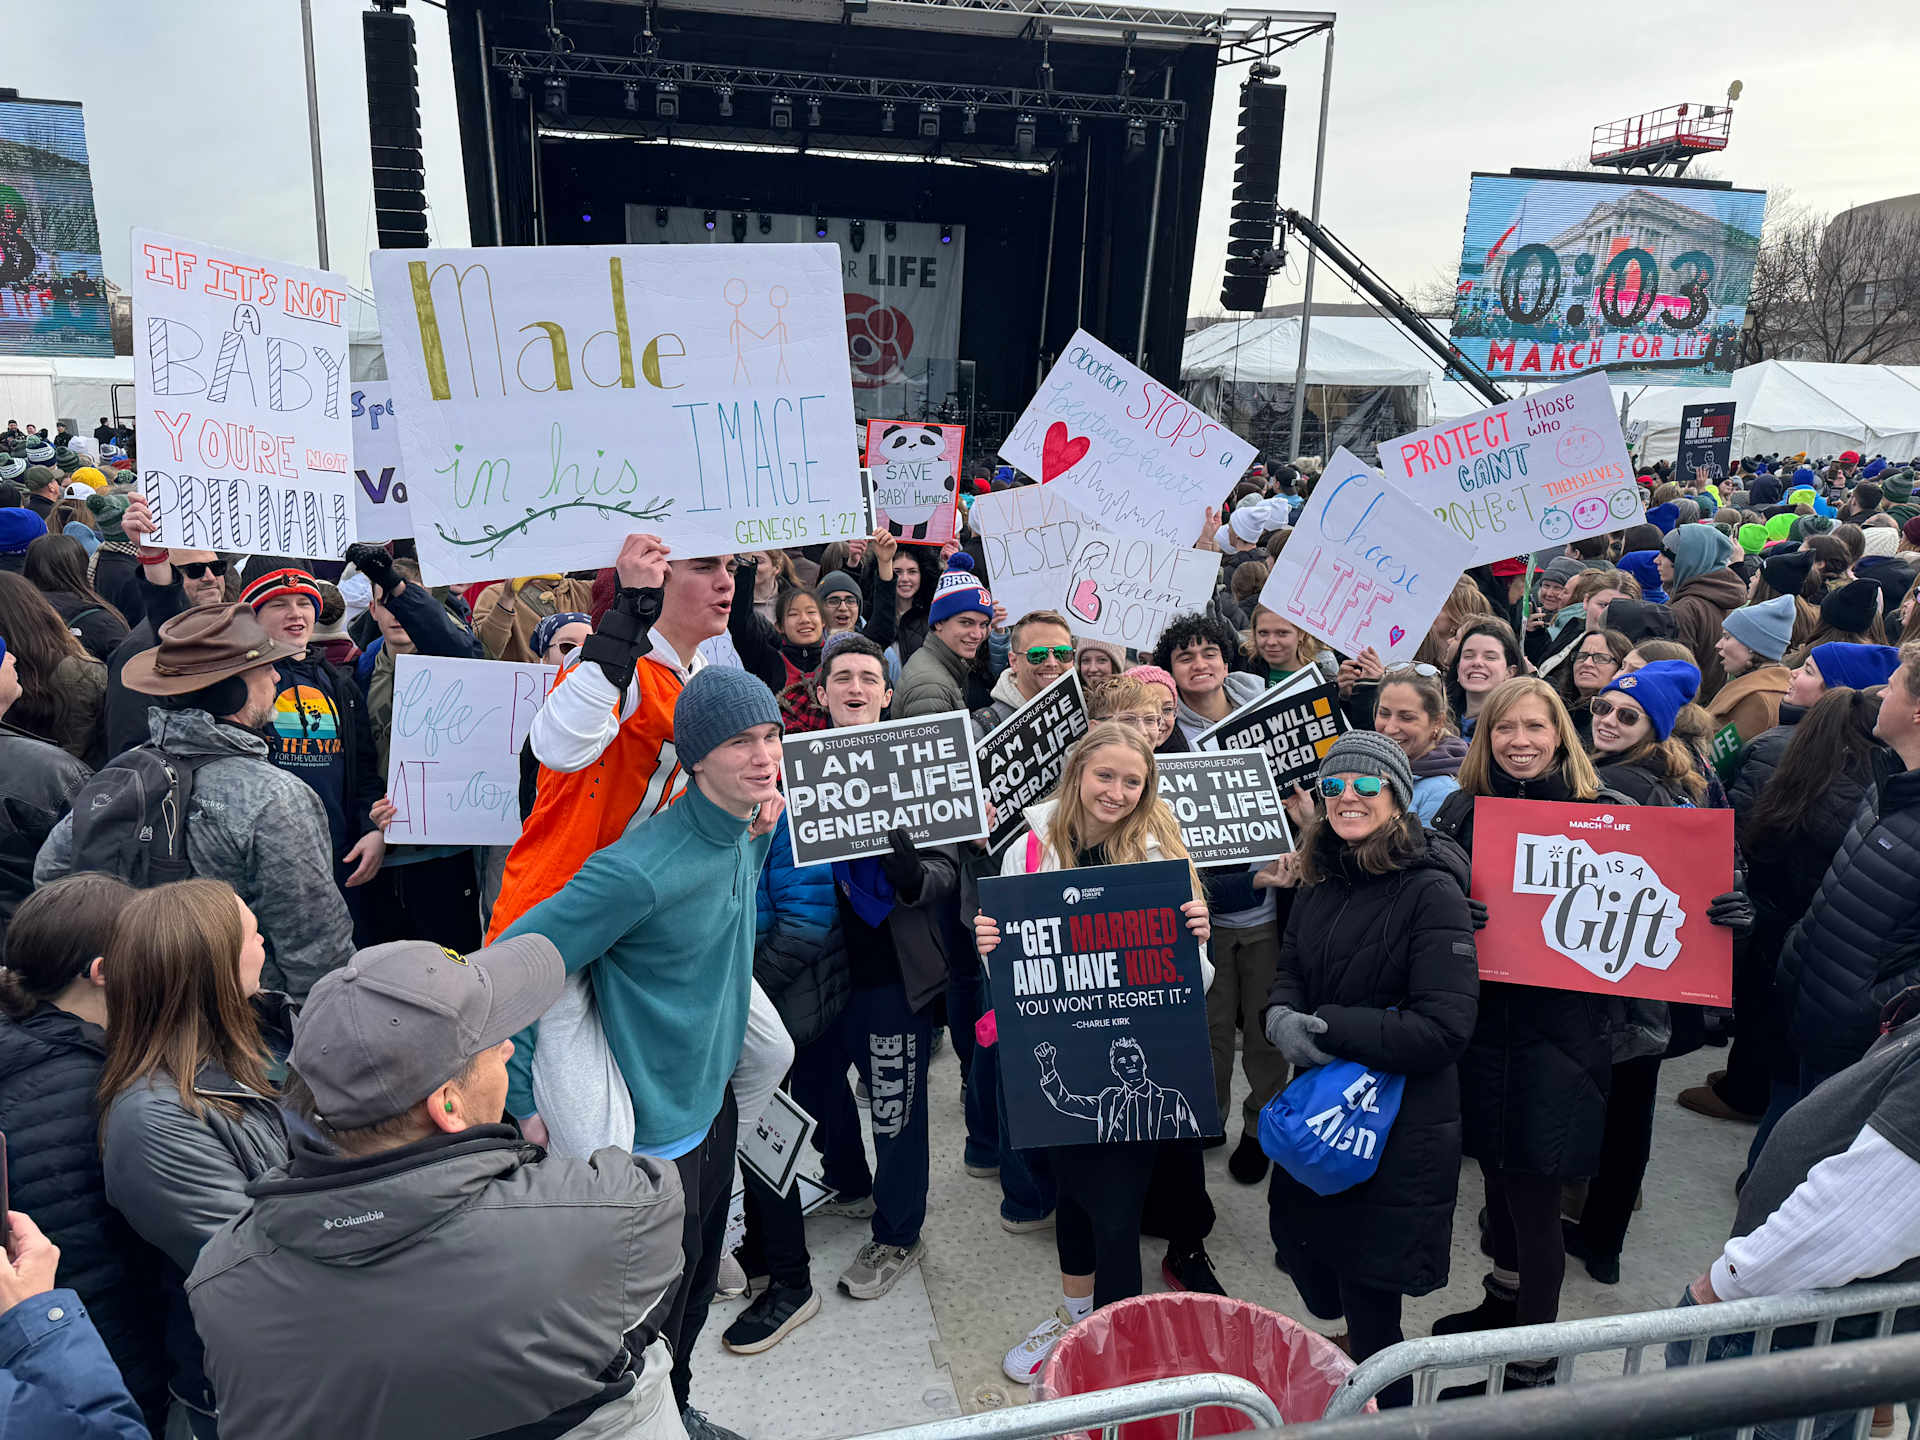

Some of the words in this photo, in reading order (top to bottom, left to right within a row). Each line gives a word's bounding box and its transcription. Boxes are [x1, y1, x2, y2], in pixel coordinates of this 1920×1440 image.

[144, 244, 197, 290] IF
[204, 258, 278, 306] IT'S
[285, 279, 346, 325] NOT
[869, 254, 937, 288] LIFE
[1500, 243, 1714, 330] 0:03
[232, 303, 261, 335] A
[408, 256, 687, 401] Made
[147, 317, 346, 420] BABY
[1487, 337, 1602, 372] MARCH
[1616, 334, 1664, 359] FOR
[1067, 346, 1129, 398] abortion
[1126, 382, 1220, 458] STOPS
[1219, 452, 1234, 468] a
[1527, 419, 1561, 438] who
[154, 409, 299, 480] YOU'RE
[306, 449, 349, 474] NOT
[434, 443, 511, 509] in
[539, 421, 639, 500] his
[671, 395, 831, 514] IMAGE
[1400, 411, 1511, 478] PROTECT
[1523, 393, 1576, 422] those
[886, 463, 933, 480] SAVE
[1541, 462, 1625, 498] THEMSELVES
[878, 488, 908, 505] BABY
[734, 514, 809, 546] GENESIS
[819, 511, 857, 537] 1:27
[1320, 470, 1422, 595] Choose
[1110, 538, 1194, 593] LOVE
[1287, 544, 1395, 654] LIFE
[824, 724, 940, 751] STUDENTSFORLIFE.ORG
[987, 688, 1060, 752] STUDENTSFORLIFE.ORG
[990, 734, 1024, 775] AM
[1029, 694, 1074, 737] THE
[1225, 722, 1265, 750] GOD
[1266, 704, 1315, 732] WILL
[1258, 730, 1300, 759] NOT
[1305, 716, 1338, 738] BE
[281, 738, 312, 754] THE
[794, 759, 804, 781] I
[821, 749, 875, 778] AM
[889, 737, 957, 766] THE
[1267, 744, 1316, 778] CKED
[1711, 729, 1739, 763] IFE
[388, 759, 441, 837] AT
[788, 761, 974, 817] PRO-LIFE
[1157, 773, 1198, 794] AM
[1207, 769, 1262, 790] THE
[798, 795, 974, 845] GENERATION
[850, 839, 870, 850] TEXT
[871, 836, 890, 847] LIFE
[908, 830, 930, 842] 3445
[1569, 820, 1602, 829] MARCH
[1614, 823, 1631, 831] LIFE
[1191, 851, 1203, 859] EXT
[1204, 848, 1218, 857] LIFE
[1219, 848, 1228, 856] TO
[1228, 846, 1250, 856] 53445
[1521, 842, 1598, 889] Life
[1606, 860, 1624, 874] IS
[1630, 867, 1643, 880] A
[1069, 907, 1178, 953] MARRIED
[1555, 881, 1674, 974] Gift
[1012, 957, 1058, 996] AND
[1061, 951, 1121, 992] HAVE
[1124, 947, 1184, 987] KIDS.
[1016, 1000, 1049, 1017] YOU
[1053, 994, 1104, 1014] WON'T
[1108, 989, 1164, 1009] REGRET
[1111, 1016, 1130, 1027] KIRK
[869, 1032, 904, 1139] BLAST
[334, 1209, 385, 1228] Columbia
